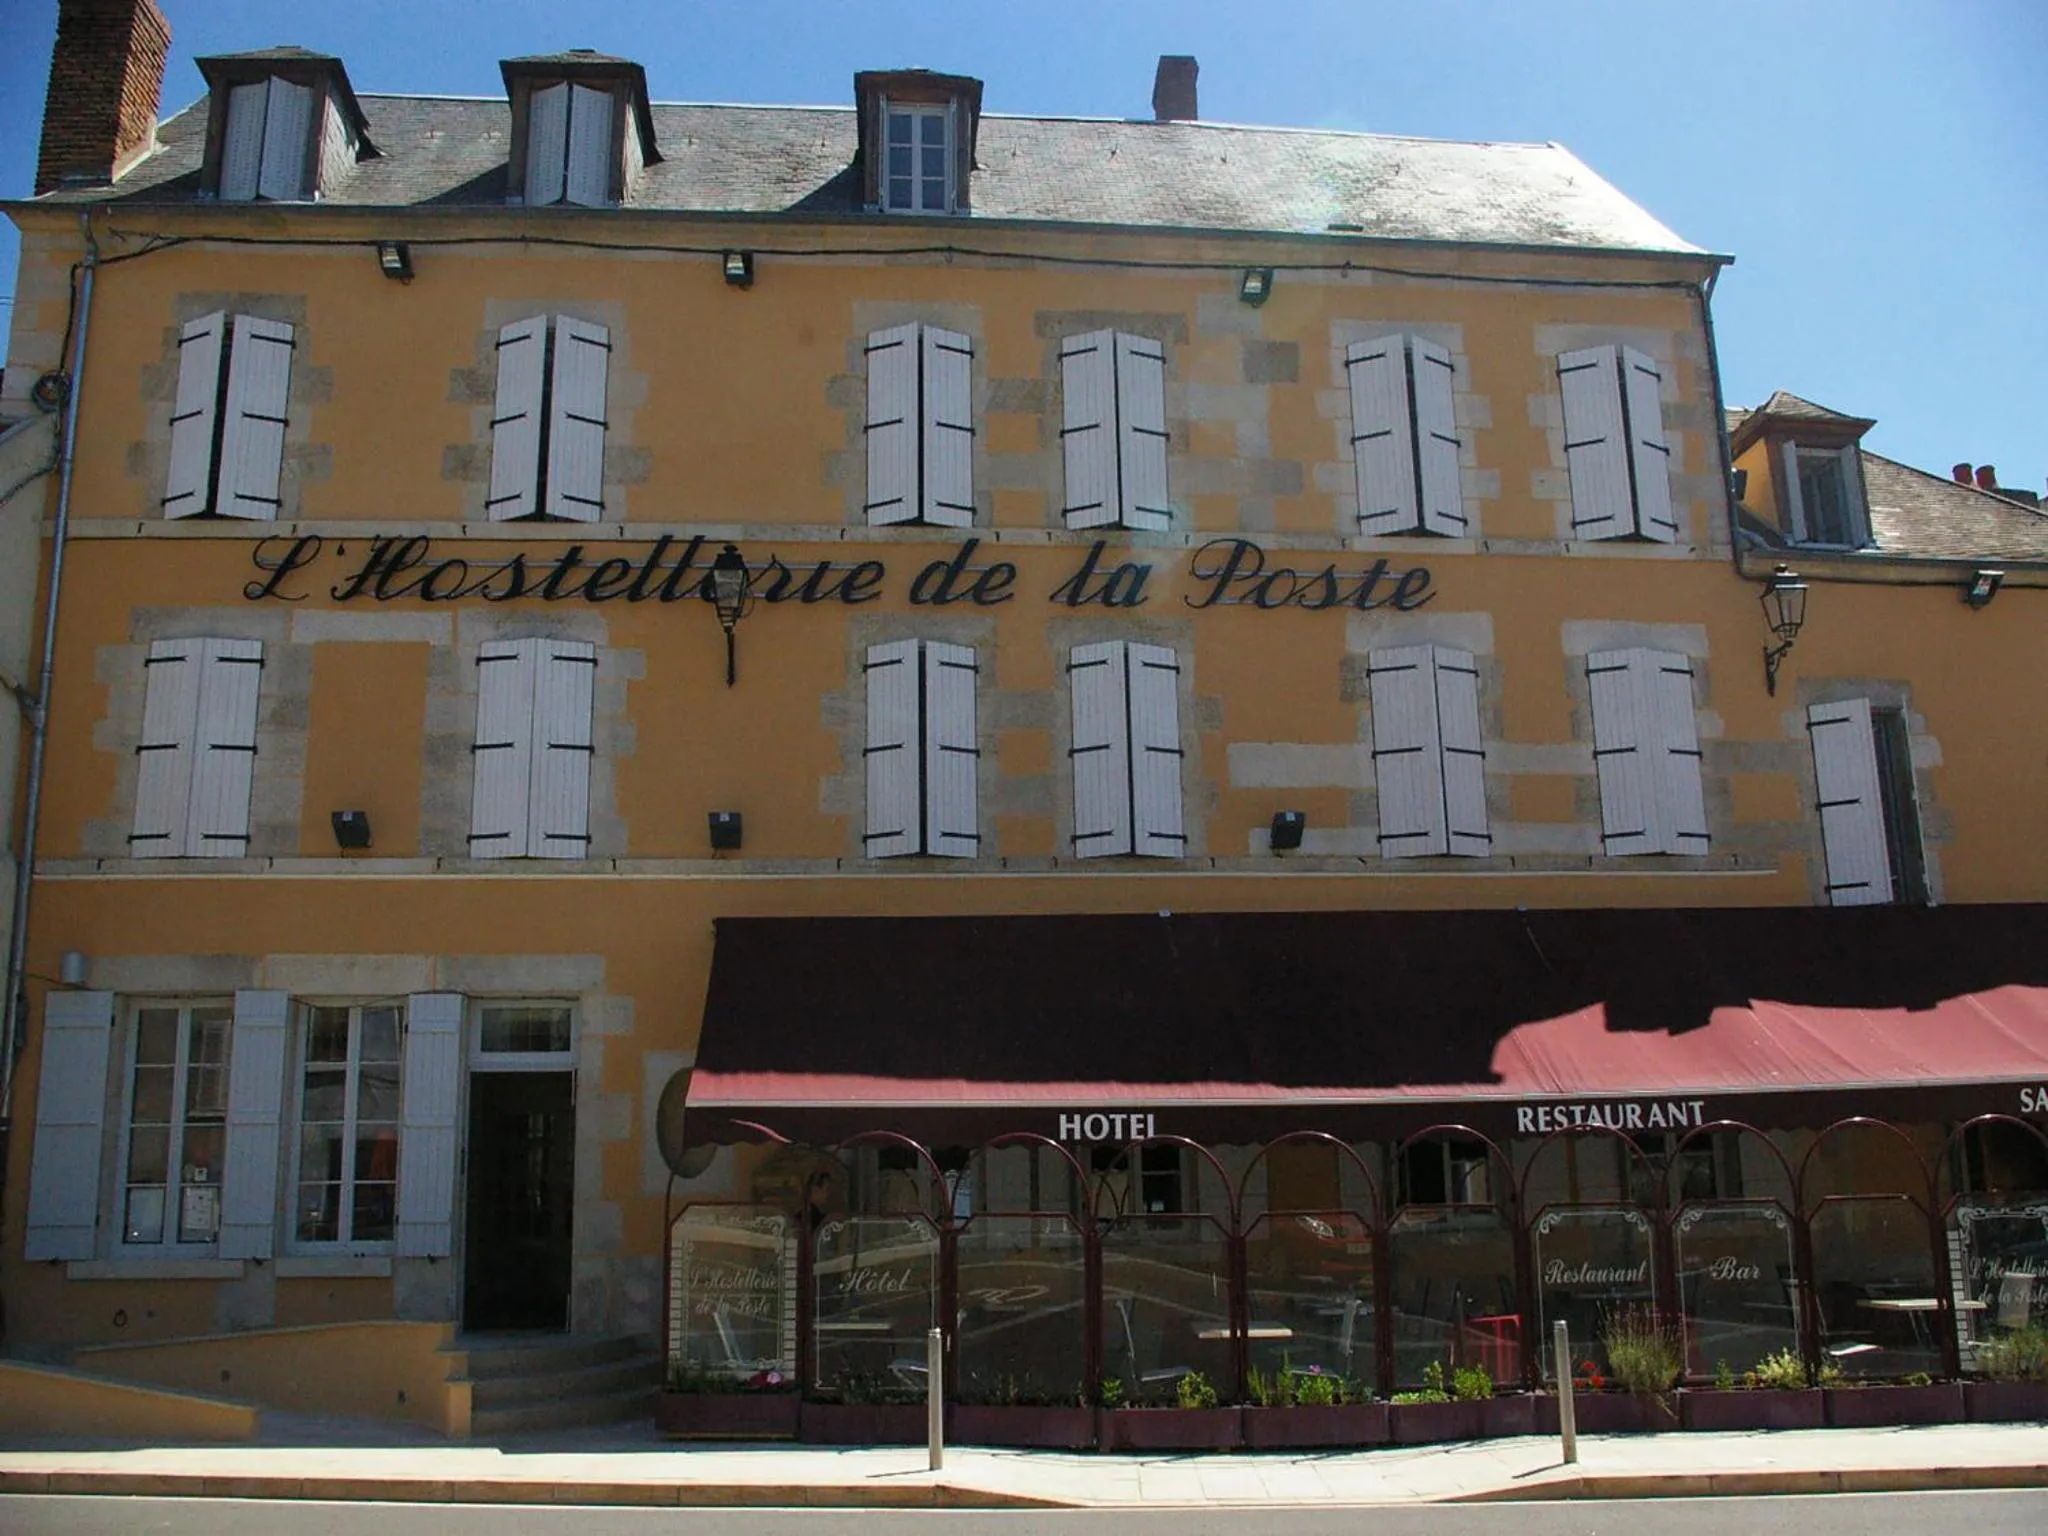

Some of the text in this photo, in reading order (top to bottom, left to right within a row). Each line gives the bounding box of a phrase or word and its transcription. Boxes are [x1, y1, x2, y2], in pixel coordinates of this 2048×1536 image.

[910, 538, 1016, 605] de
[1050, 539, 1154, 608] la
[1185, 538, 1436, 611] Poste
[1517, 1101, 1705, 1133] RESTAURANT
[839, 1267, 911, 1293] Hôtel
[1544, 1258, 1649, 1285] Restaurant
[1709, 1256, 1761, 1280] Bar
